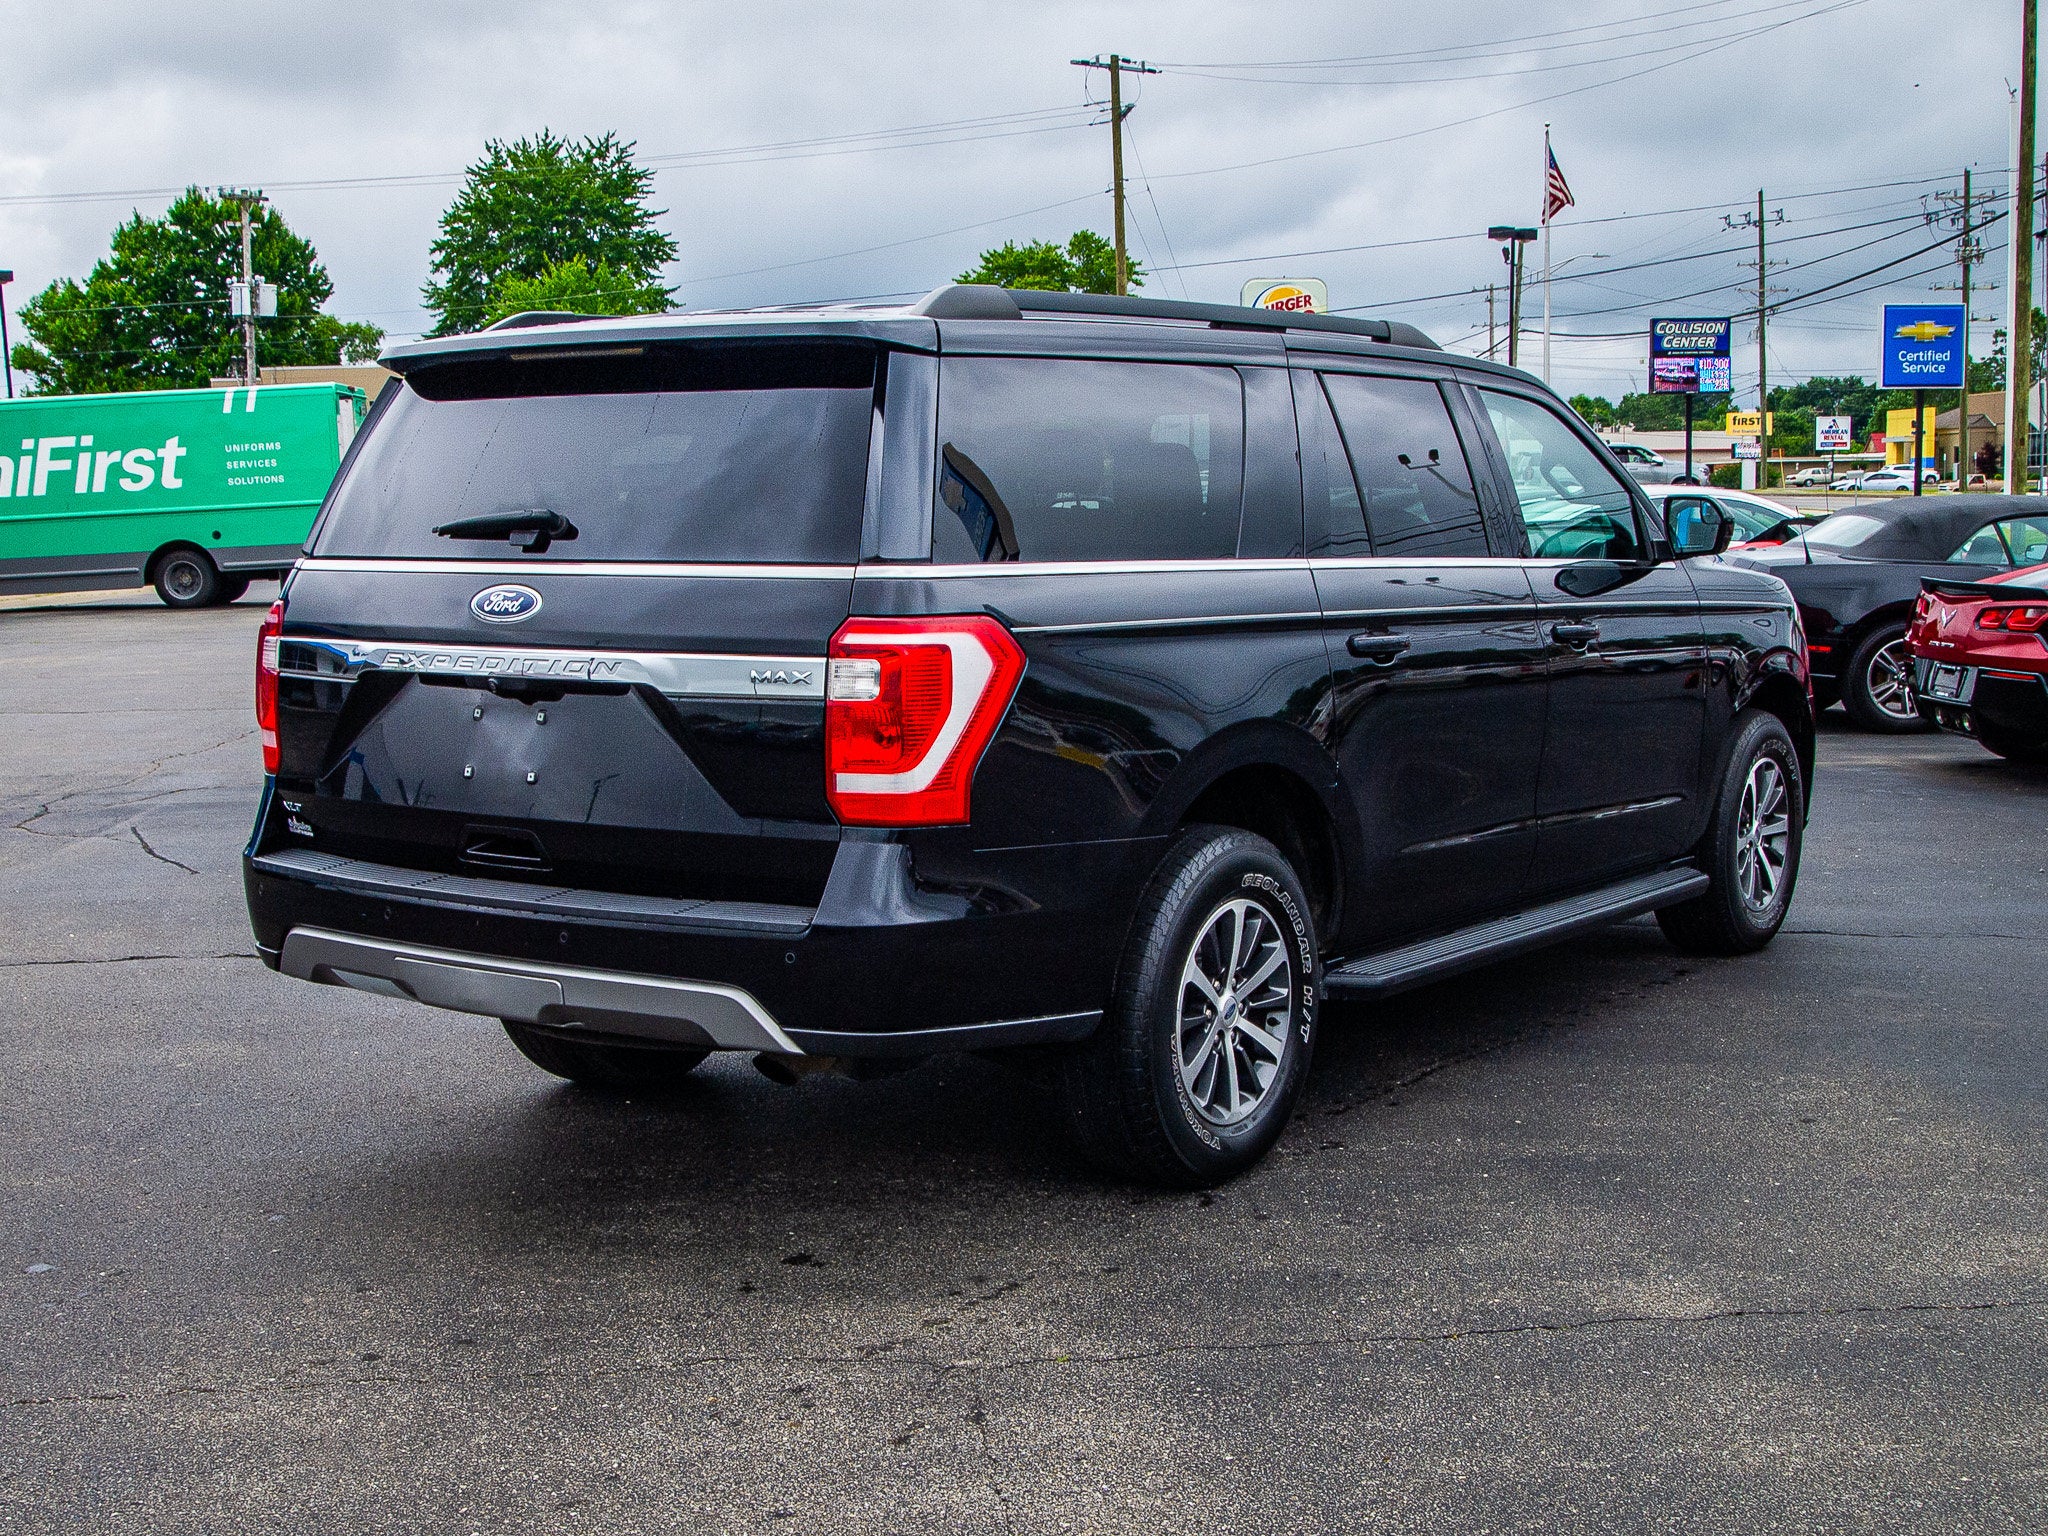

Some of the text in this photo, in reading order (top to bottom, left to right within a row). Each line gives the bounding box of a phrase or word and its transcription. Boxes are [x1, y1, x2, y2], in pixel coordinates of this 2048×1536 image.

[1655, 321, 1727, 335] COLLISION
[1662, 336, 1716, 348] CENTER
[1898, 349, 1951, 362] Certified
[1902, 361, 1946, 373] Service
[224, 442, 281, 453] UNIFORMS
[226, 458, 278, 470] SERVICES
[227, 474, 285, 486] SOLUTIONS
[483, 591, 525, 613] Ford
[381, 650, 622, 677] EXPEDITION
[750, 669, 813, 685] MAX
[1241, 873, 1312, 974] GEOLANDAR
